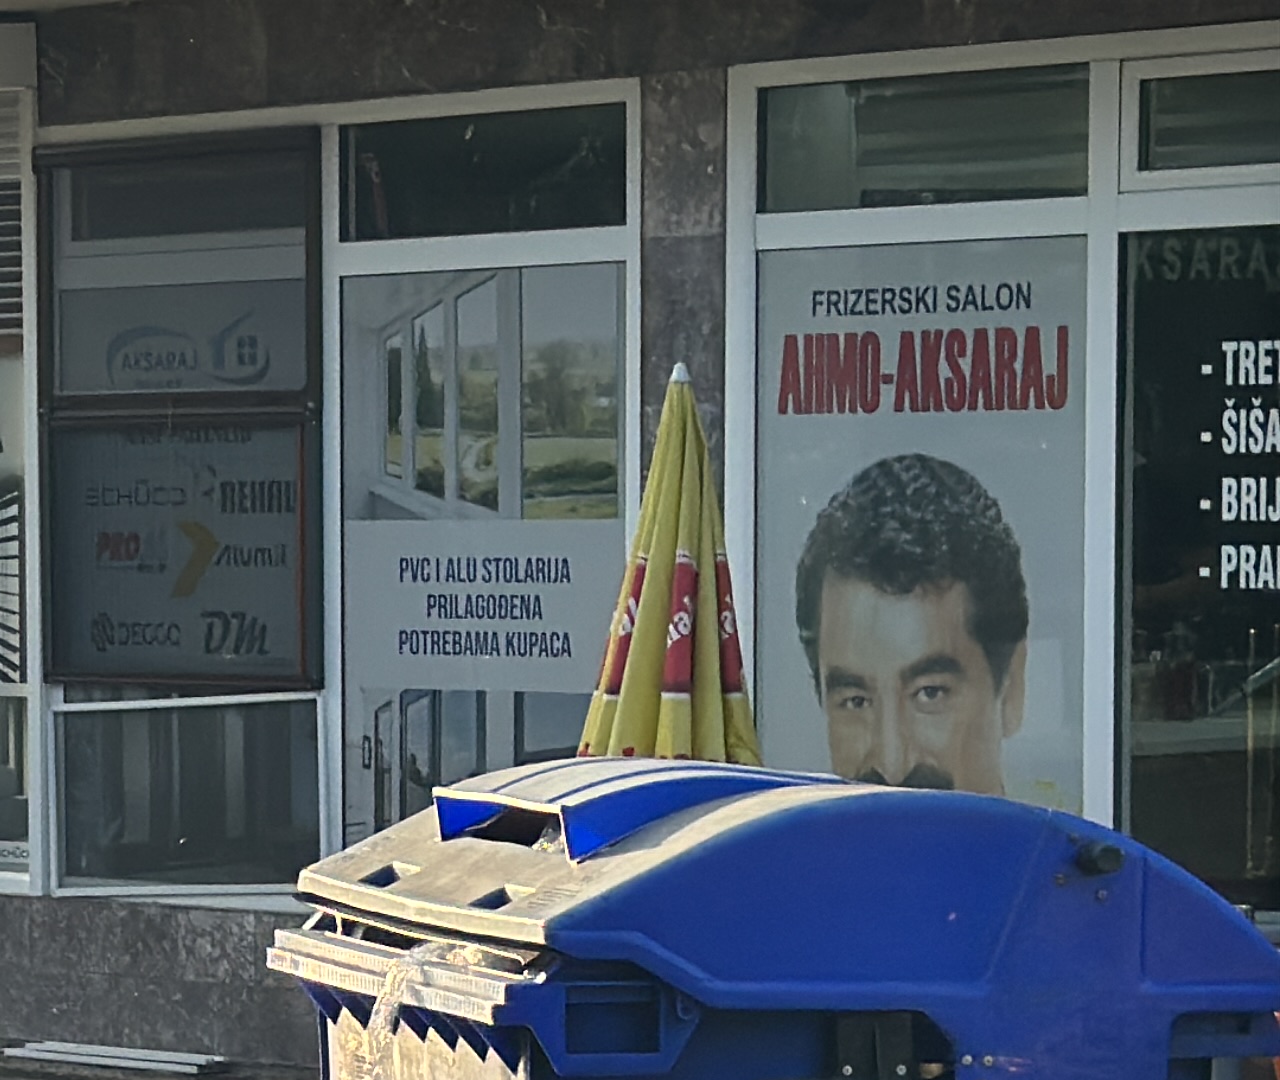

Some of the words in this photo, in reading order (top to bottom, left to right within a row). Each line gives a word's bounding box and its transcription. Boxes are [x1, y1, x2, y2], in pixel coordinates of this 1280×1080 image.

[811, 285, 939, 318] FRIZERSKI
[945, 280, 1032, 313] SALON
[121, 348, 198, 371] AKSARAJ
[777, 324, 1070, 415] AHMO-AKSARAJ
[399, 556, 431, 583] PVC
[435, 556, 441, 583] I
[445, 556, 477, 584] ALU
[481, 556, 571, 584] STOLARIJA
[1220, 544, 1280, 590] PRA
[426, 593, 543, 620] PRILAGOĐENA
[398, 629, 501, 657] POTREBAMA
[505, 631, 572, 658] KUPACA
